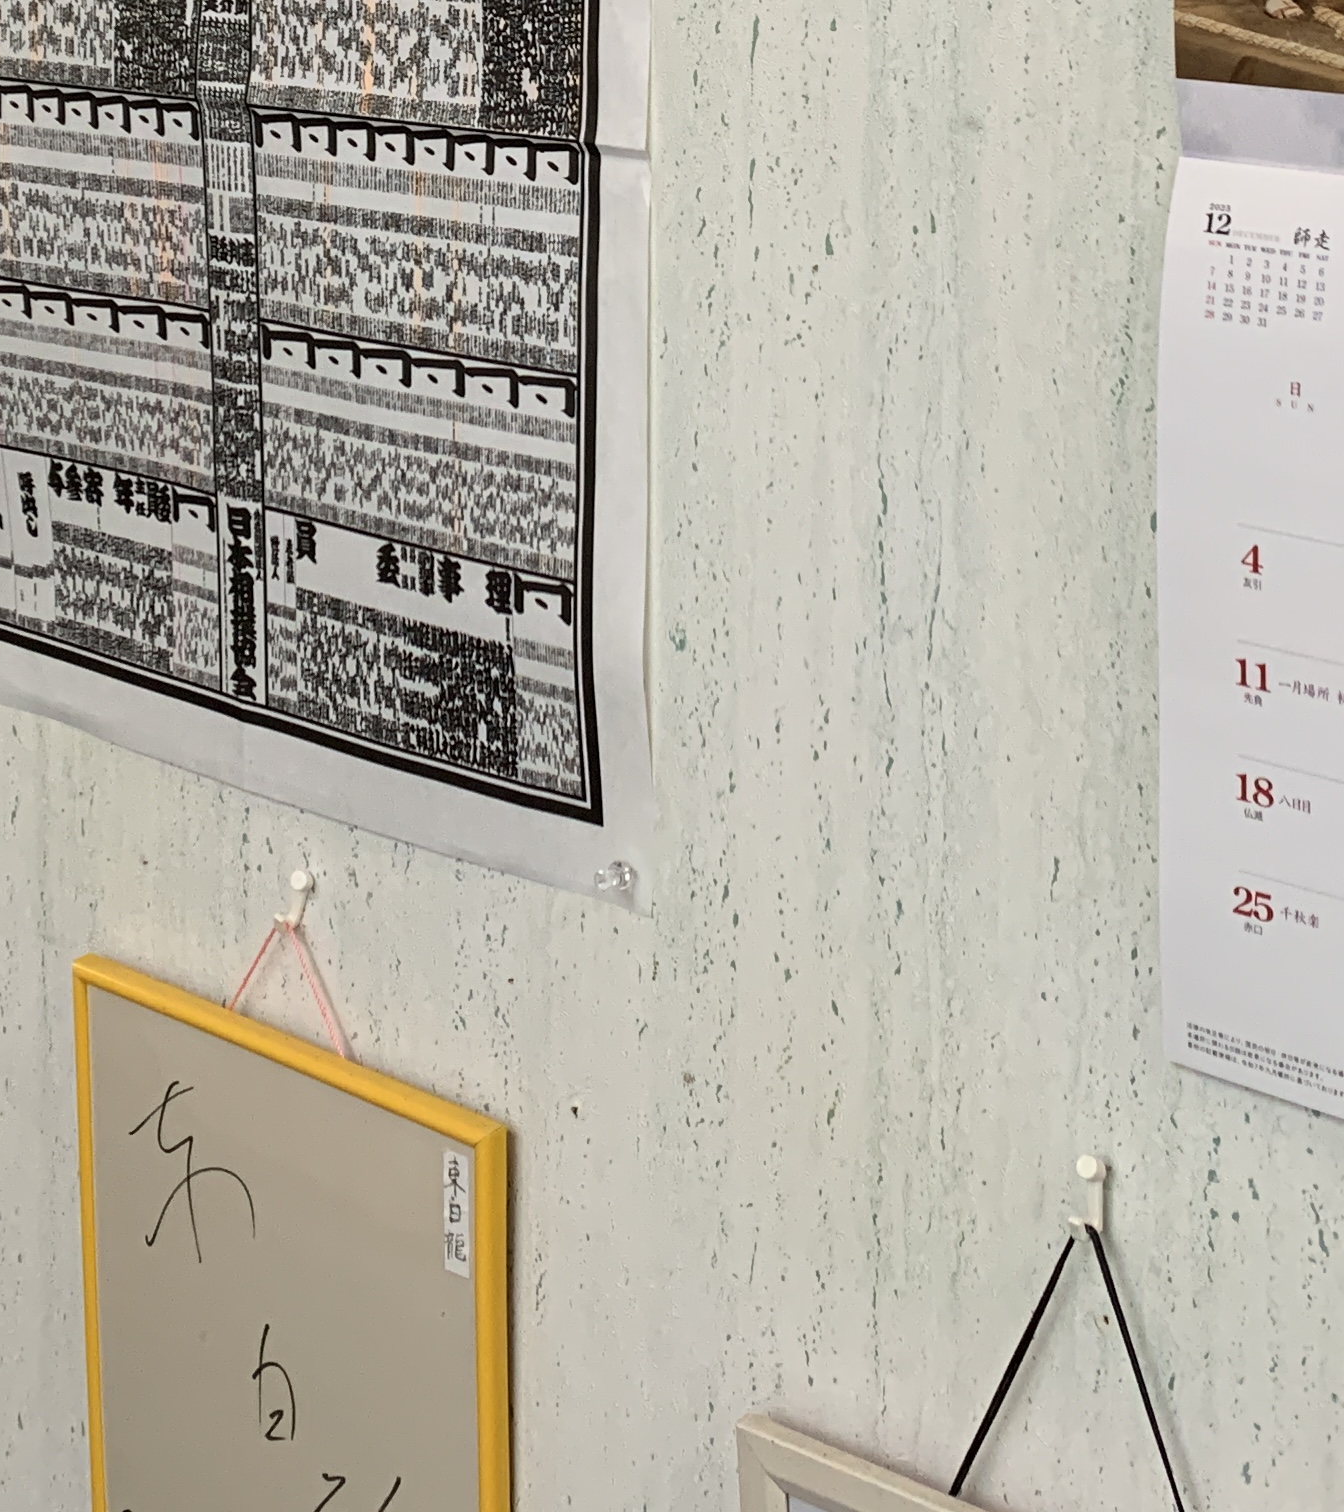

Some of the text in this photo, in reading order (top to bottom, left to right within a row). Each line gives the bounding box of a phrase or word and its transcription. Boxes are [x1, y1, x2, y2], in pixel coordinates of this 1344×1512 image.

[1203, 213, 1232, 236] 12
[1293, 226, 1331, 251] 師走
[1290, 382, 1301, 397] 日
[1241, 545, 1263, 575] 4
[1242, 577, 1262, 592] 友引
[1236, 659, 1270, 693] 11
[1243, 693, 1263, 708] 先負
[1279, 681, 1329, 701] 一月場所
[1237, 774, 1274, 808] 18
[1243, 808, 1264, 822] 仏滅
[1278, 795, 1311, 815] 八日目
[1233, 887, 1273, 922] 25
[1281, 907, 1318, 928] 千秋楽
[1243, 922, 1263, 936] 赤口
[444, 1157, 467, 1262] 東白龍
